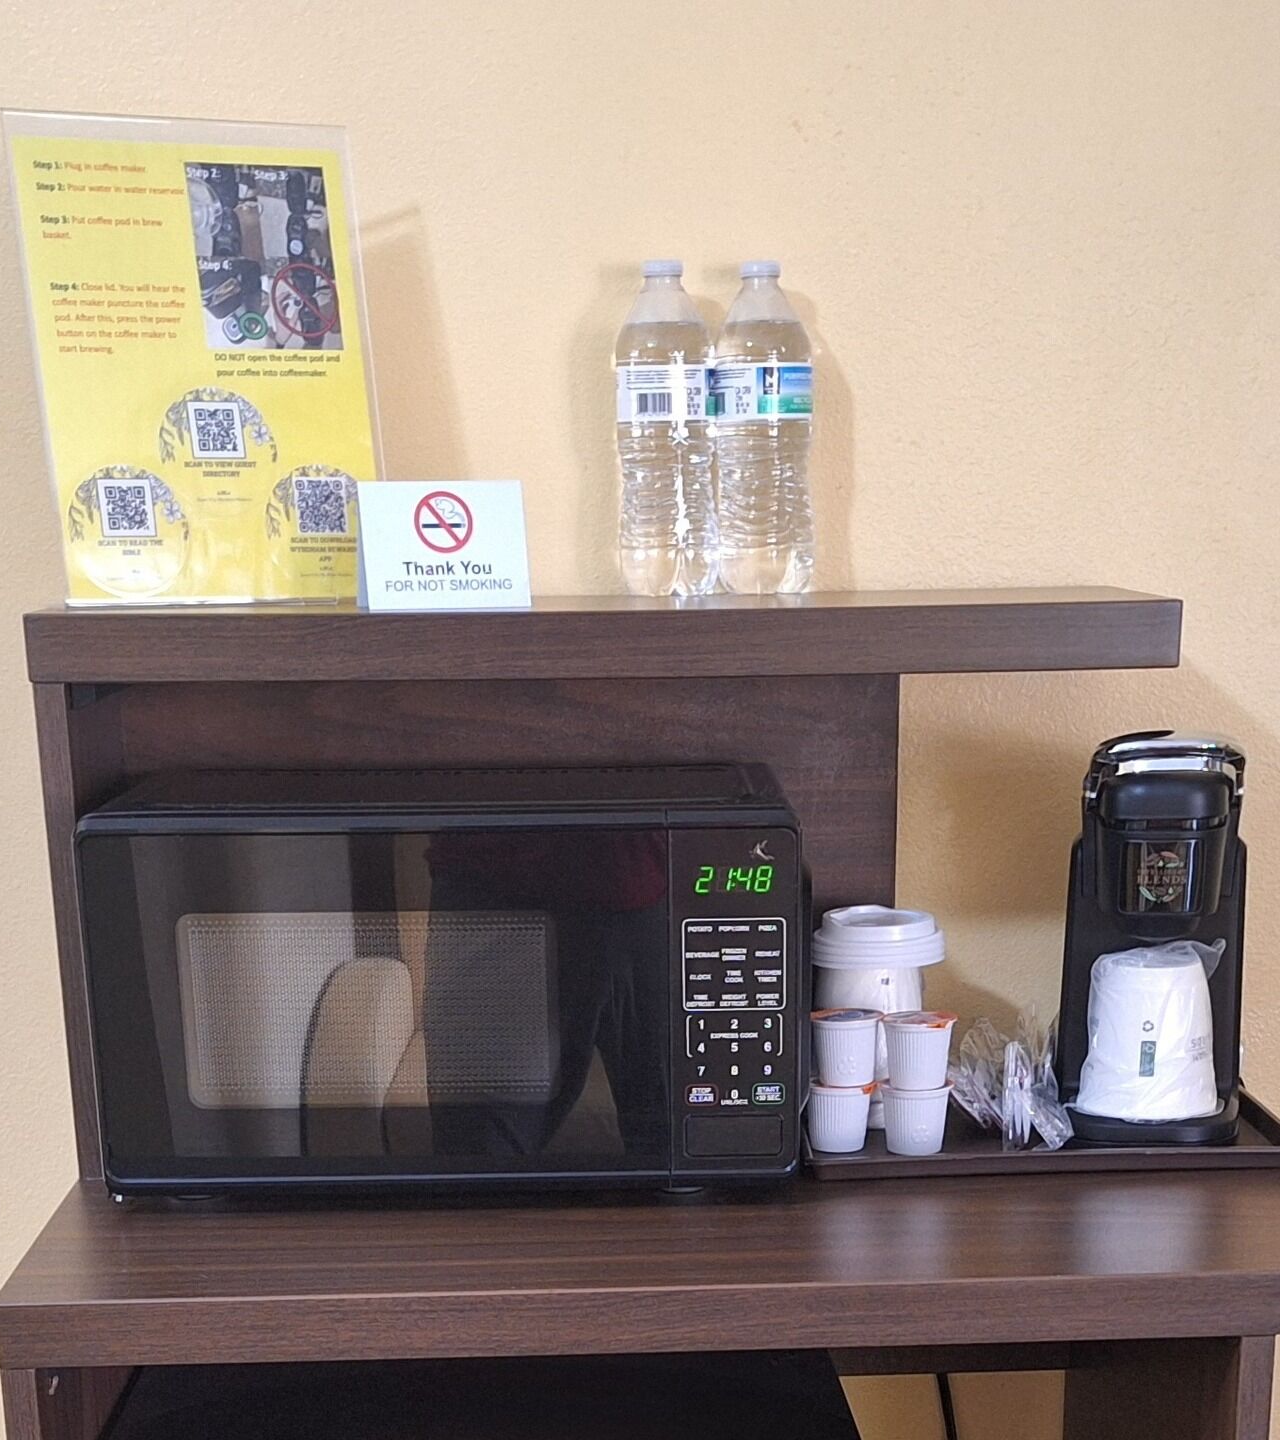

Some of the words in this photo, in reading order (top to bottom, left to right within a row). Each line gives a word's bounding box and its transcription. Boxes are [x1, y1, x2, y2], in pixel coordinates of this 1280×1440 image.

[33, 160, 53, 170] Step
[55, 161, 62, 170] 1:
[186, 167, 209, 179] Step
[211, 168, 221, 178] 2:
[254, 170, 277, 181] Step
[279, 171, 289, 181] 3:
[36, 182, 55, 192] Step
[58, 183, 65, 191] 2:
[40, 215, 60, 225] Step
[62, 215, 70, 224] 3:
[72, 216, 85, 225] Put
[88, 216, 112, 225] coffee
[115, 217, 130, 227] pod
[133, 217, 141, 225] in
[143, 218, 162, 226] brew
[199, 260, 221, 271] Step
[222, 261, 232, 270] 4:
[50, 282, 69, 292] Step
[71, 283, 79, 291] 4:
[81, 283, 103, 291] Close
[120, 284, 134, 292] You
[137, 284, 150, 292] will
[172, 285, 185, 293] the
[52, 299, 77, 307] coffee
[146, 300, 159, 308] the
[75, 314, 95, 322] After
[117, 316, 138, 324] press
[57, 330, 84, 338] button
[99, 330, 112, 338] the
[115, 330, 138, 338] coffee
[215, 353, 227, 361] DO
[284, 354, 307, 362] coffee
[310, 355, 324, 363] pod
[237, 369, 260, 377] coffee
[263, 369, 278, 377] into
[403, 561, 455, 576] Thank
[461, 560, 492, 575] You
[385, 580, 415, 592] FOR
[418, 580, 446, 592] NOT
[450, 579, 513, 591] SMOKING
[695, 865, 773, 893] 21:48
[698, 1019, 705, 1030] 1
[730, 1019, 739, 1030] 2
[764, 1018, 772, 1029] 3
[697, 1043, 705, 1053] 4
[731, 1043, 739, 1053] 5
[764, 1042, 772, 1052] 6
[698, 1066, 706, 1077] 7
[731, 1065, 739, 1076] 8
[764, 1065, 772, 1076] 9
[731, 1089, 739, 1099] 0
